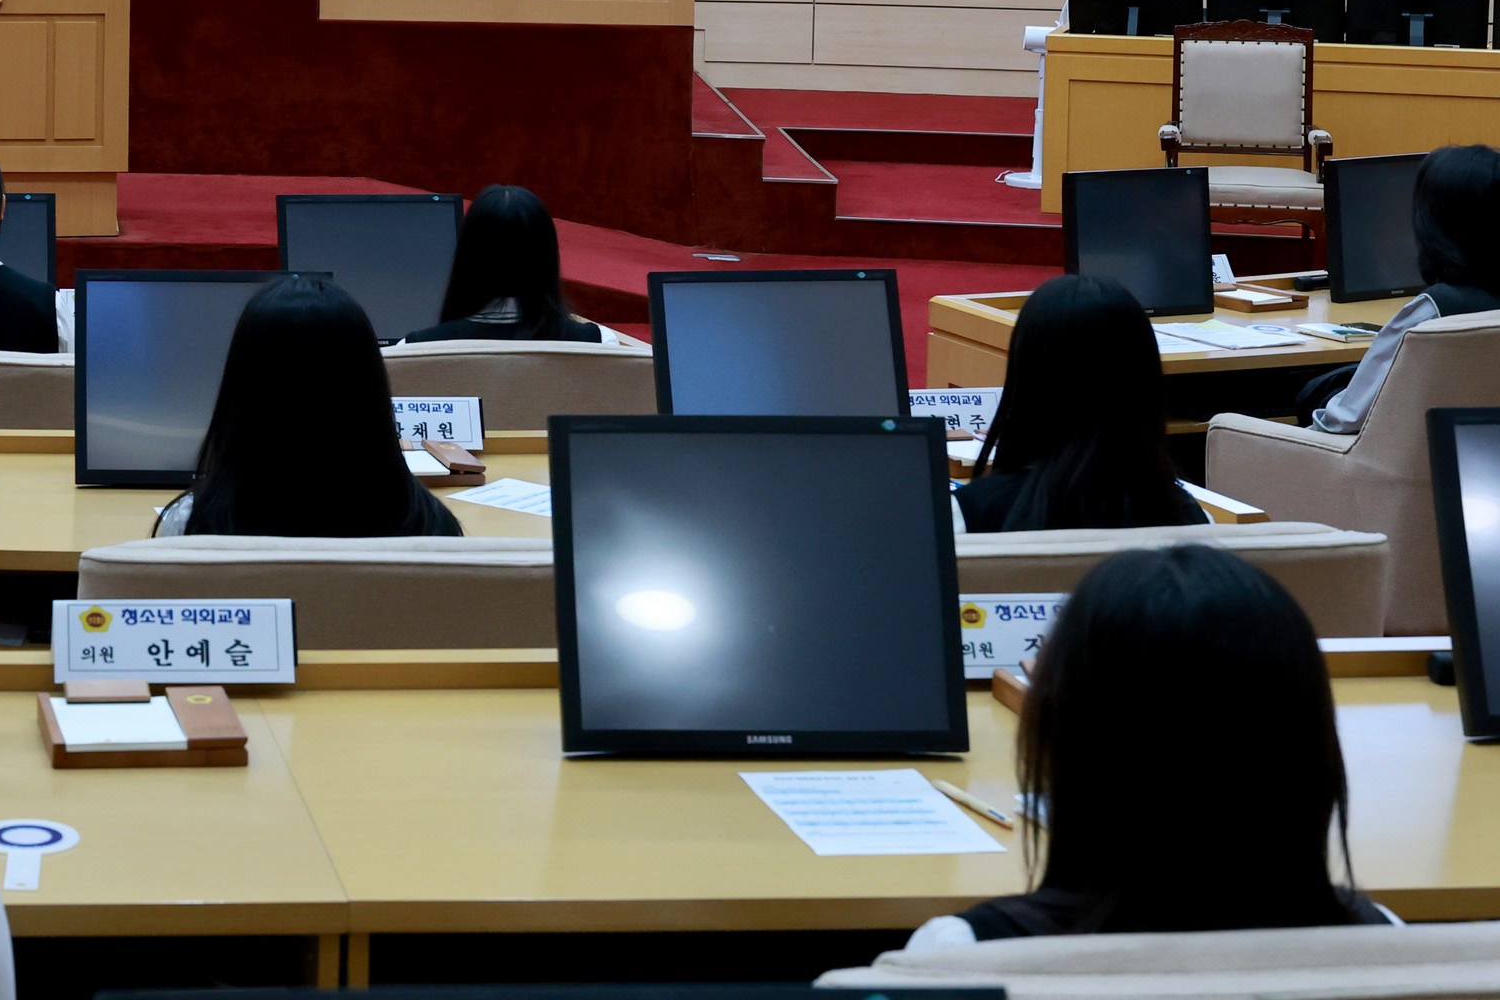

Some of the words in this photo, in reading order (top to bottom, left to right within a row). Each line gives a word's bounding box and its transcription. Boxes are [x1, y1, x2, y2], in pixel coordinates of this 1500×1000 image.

[121, 608, 174, 626] 청소년
[994, 604, 1047, 622] 청소년
[81, 646, 115, 664] 의원
[746, 735, 793, 744] SAMSUNG
